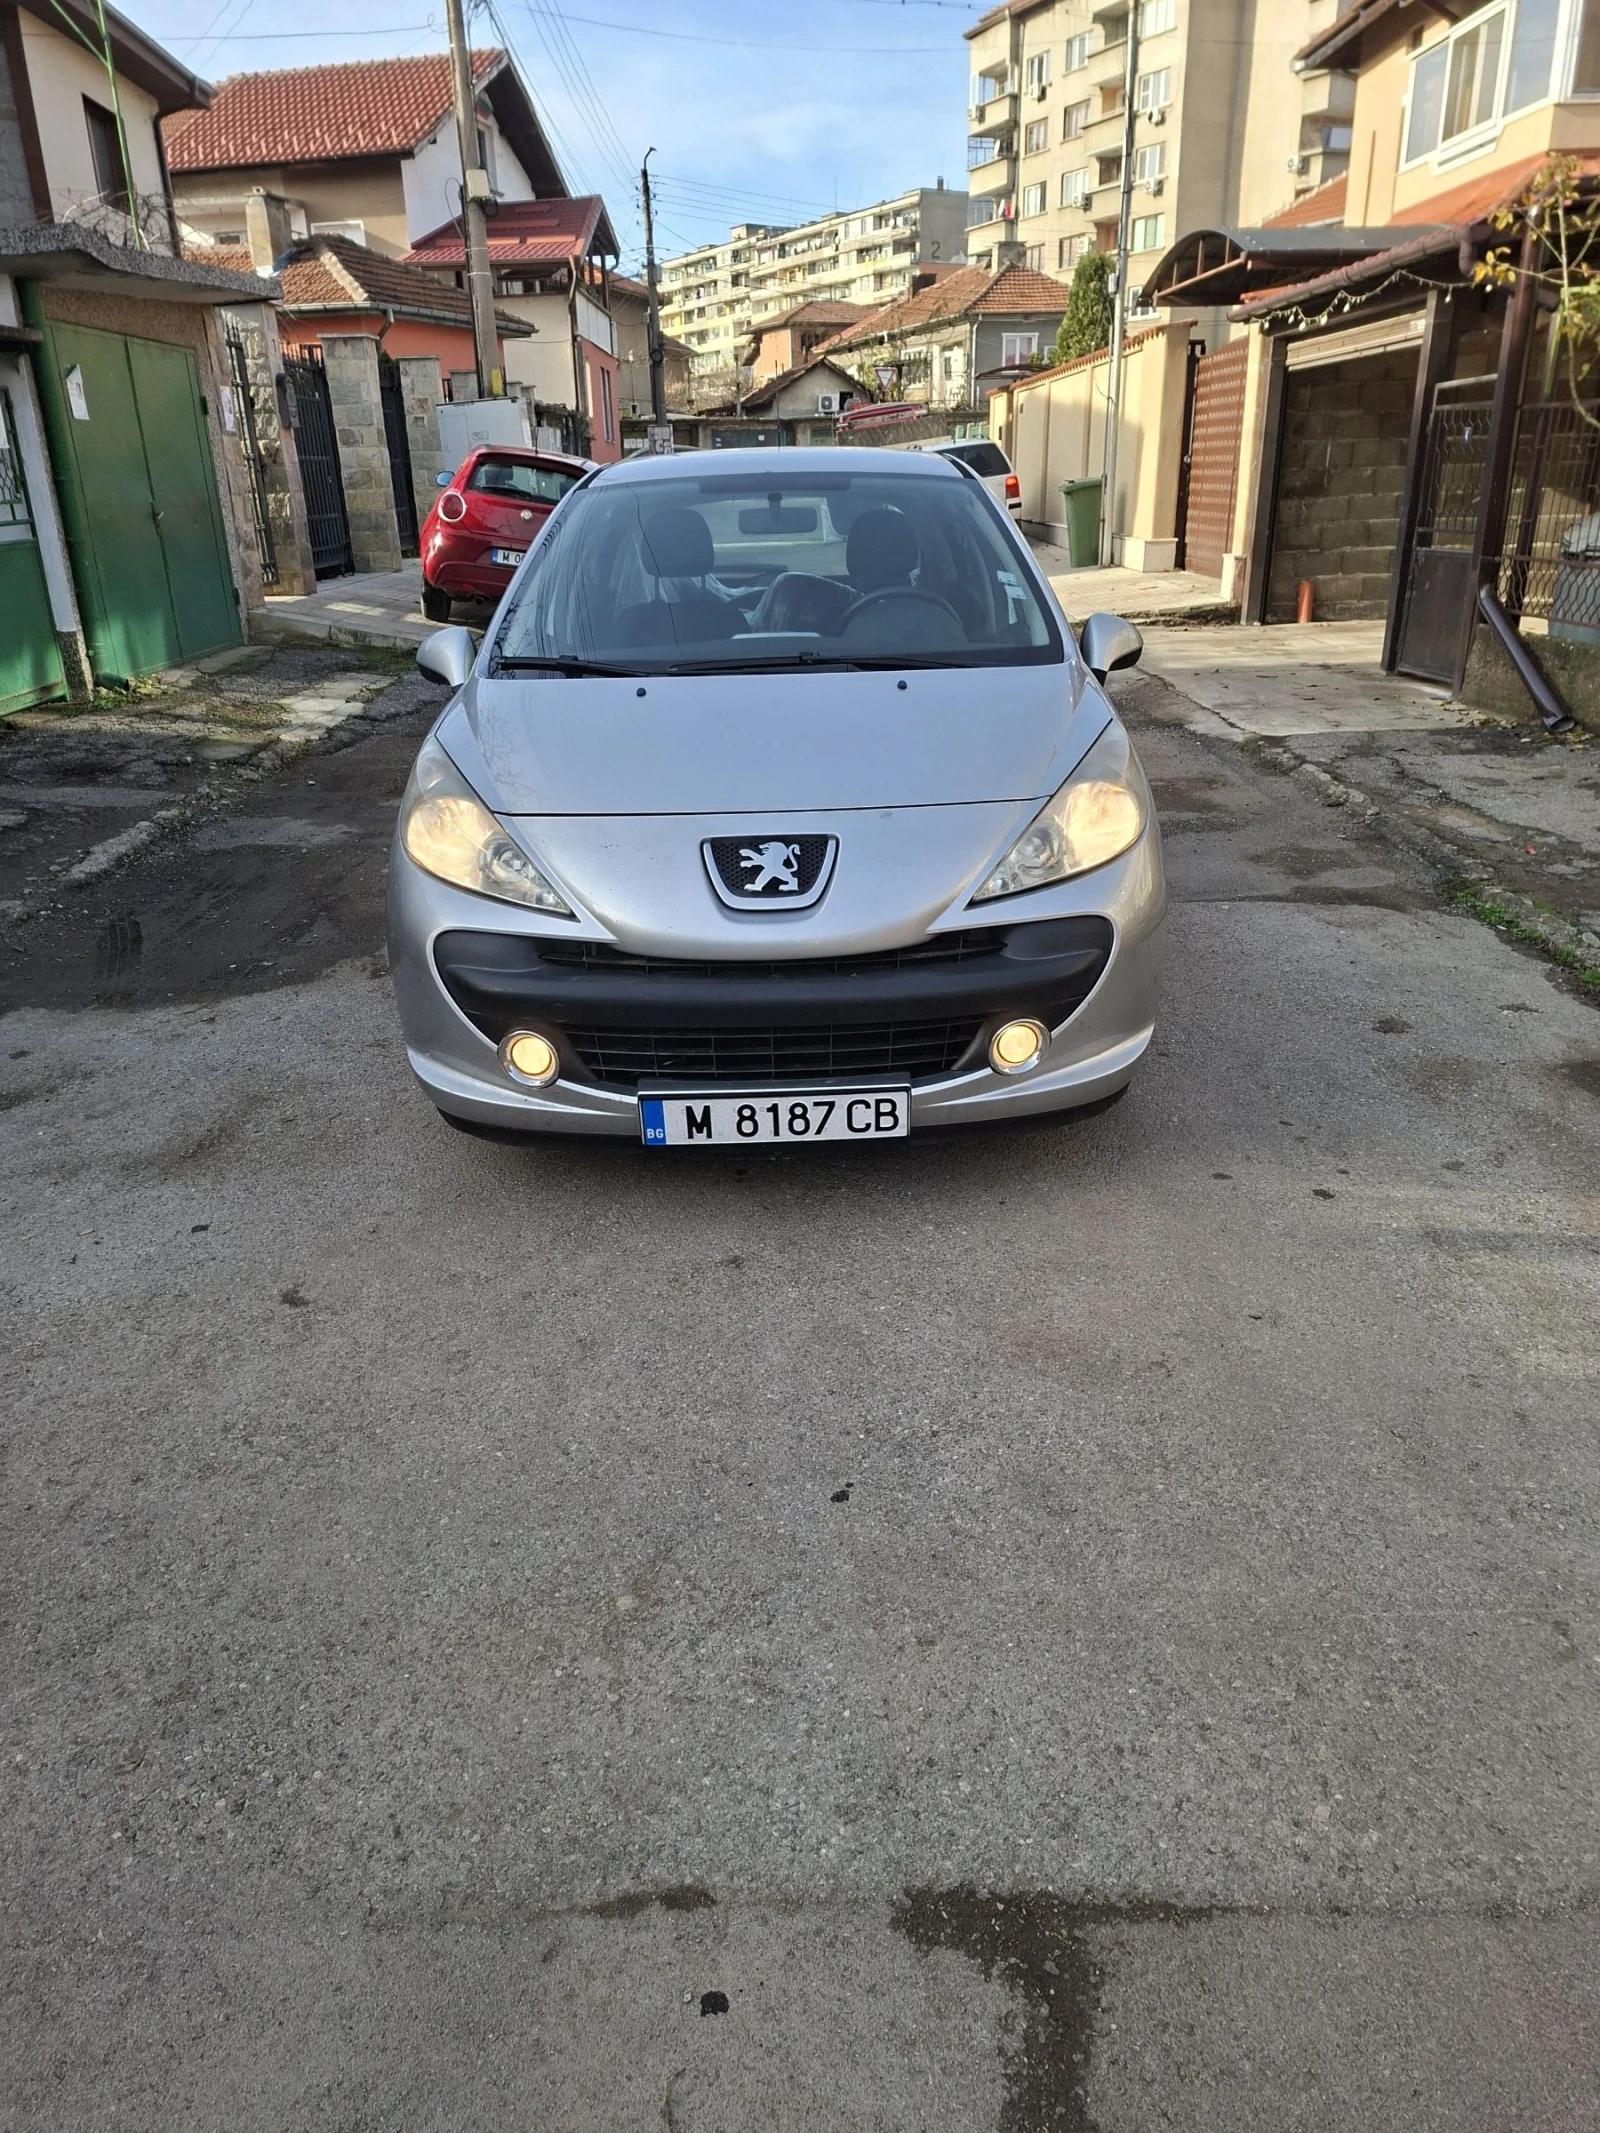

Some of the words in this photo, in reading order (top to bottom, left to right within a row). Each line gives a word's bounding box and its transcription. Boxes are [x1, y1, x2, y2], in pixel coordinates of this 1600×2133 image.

[931, 240, 941, 259] 2
[502, 551, 510, 562] M
[685, 1104, 713, 1140] M
[735, 1100, 836, 1138] 8187
[846, 1097, 899, 1134] CB
[646, 1128, 664, 1139] BG
